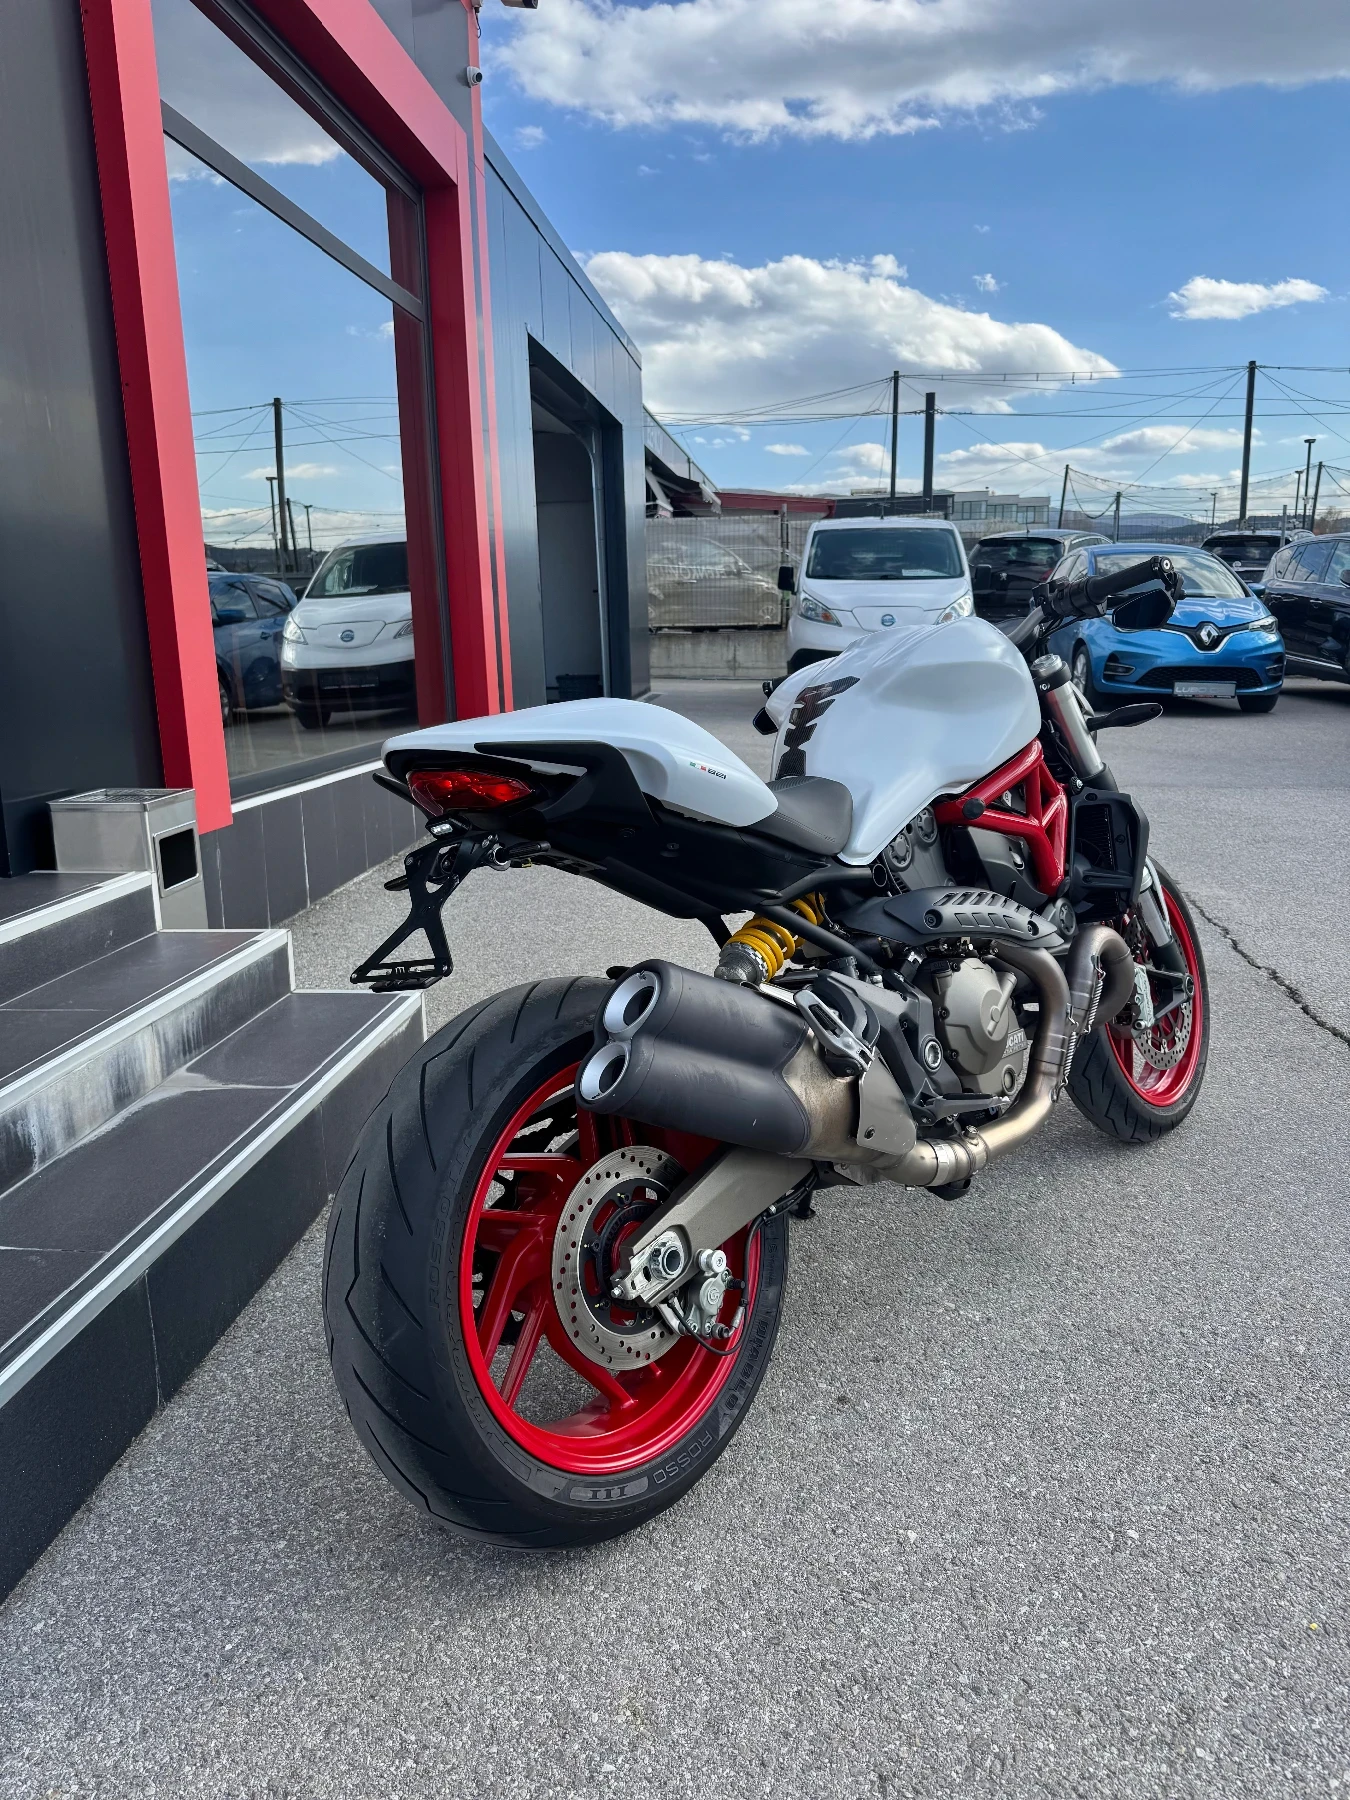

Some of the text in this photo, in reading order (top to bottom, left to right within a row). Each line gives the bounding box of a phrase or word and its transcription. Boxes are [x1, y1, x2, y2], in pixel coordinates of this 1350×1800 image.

[589, 1319, 769, 1500] DIABLO ROSSO III
